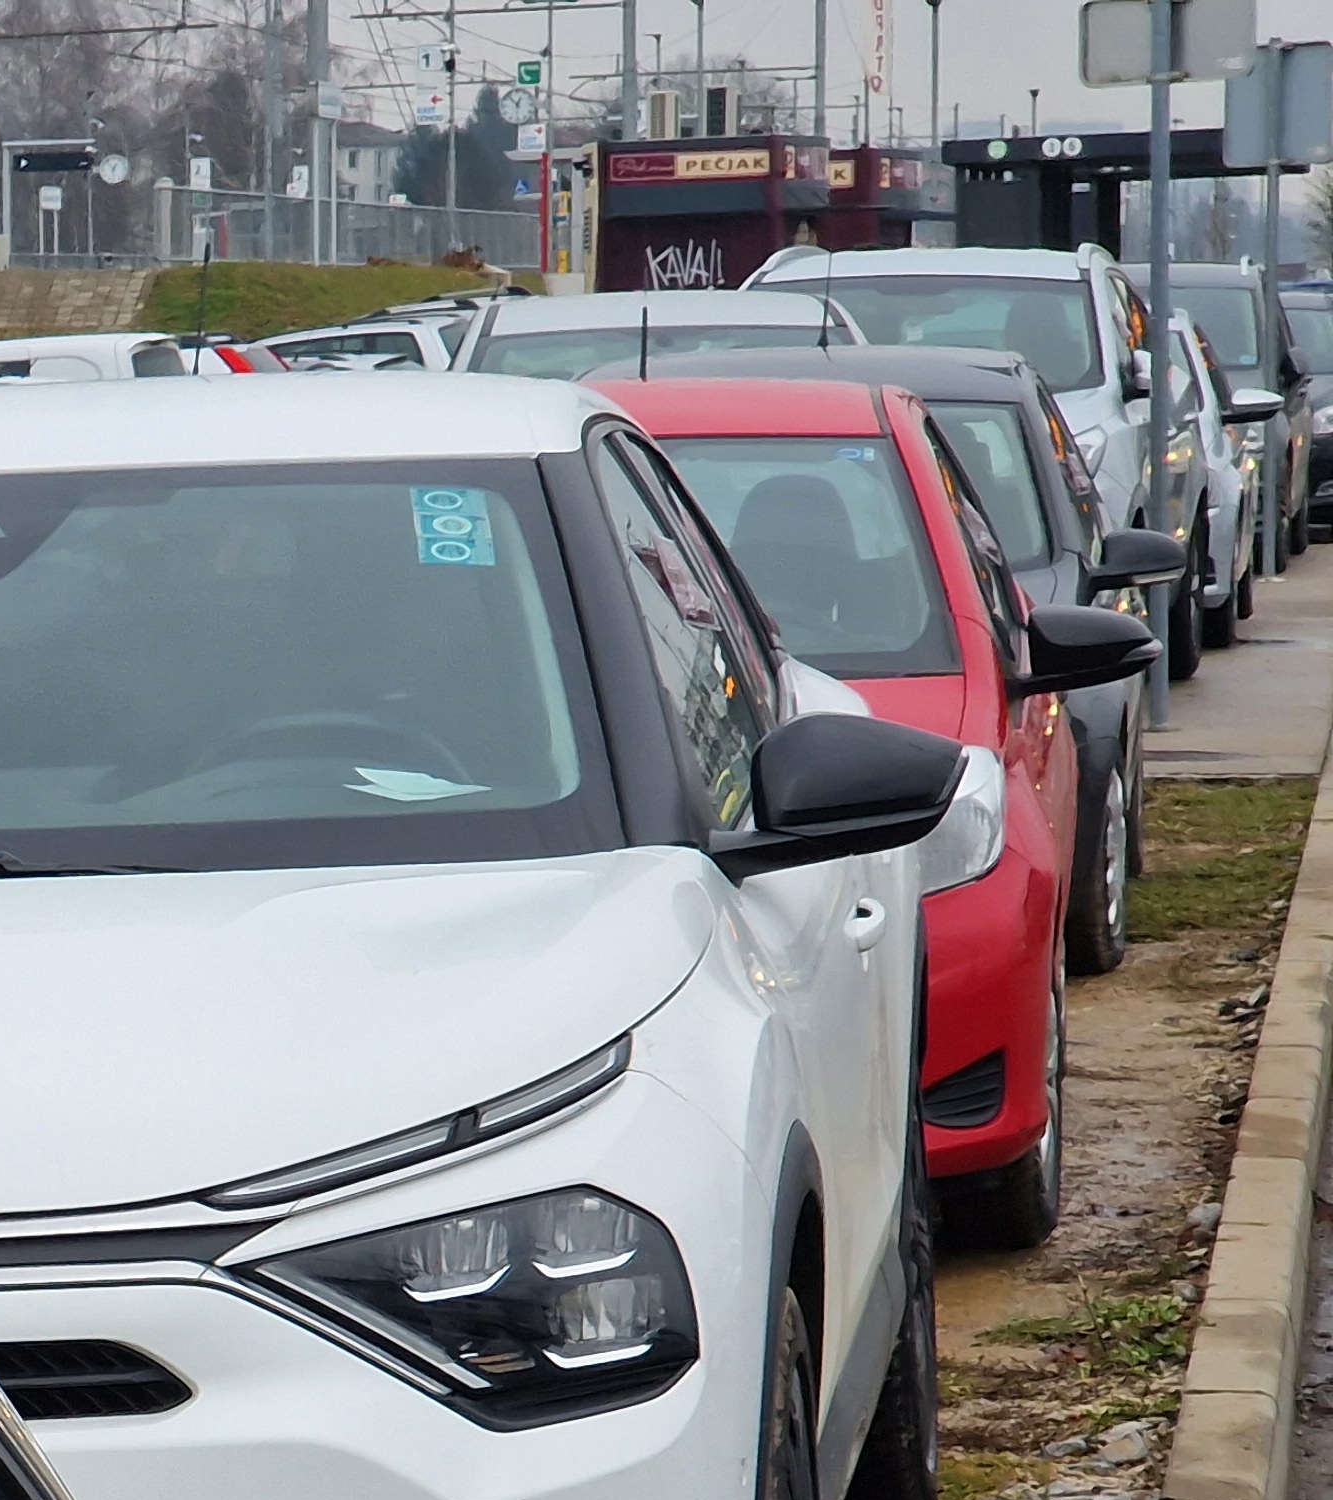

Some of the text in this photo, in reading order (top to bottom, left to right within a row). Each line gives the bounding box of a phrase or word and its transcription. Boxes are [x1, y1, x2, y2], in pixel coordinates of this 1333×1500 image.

[421, 53, 430, 68] 1
[685, 156, 766, 171] PEČJAK
[833, 168, 846, 181] K
